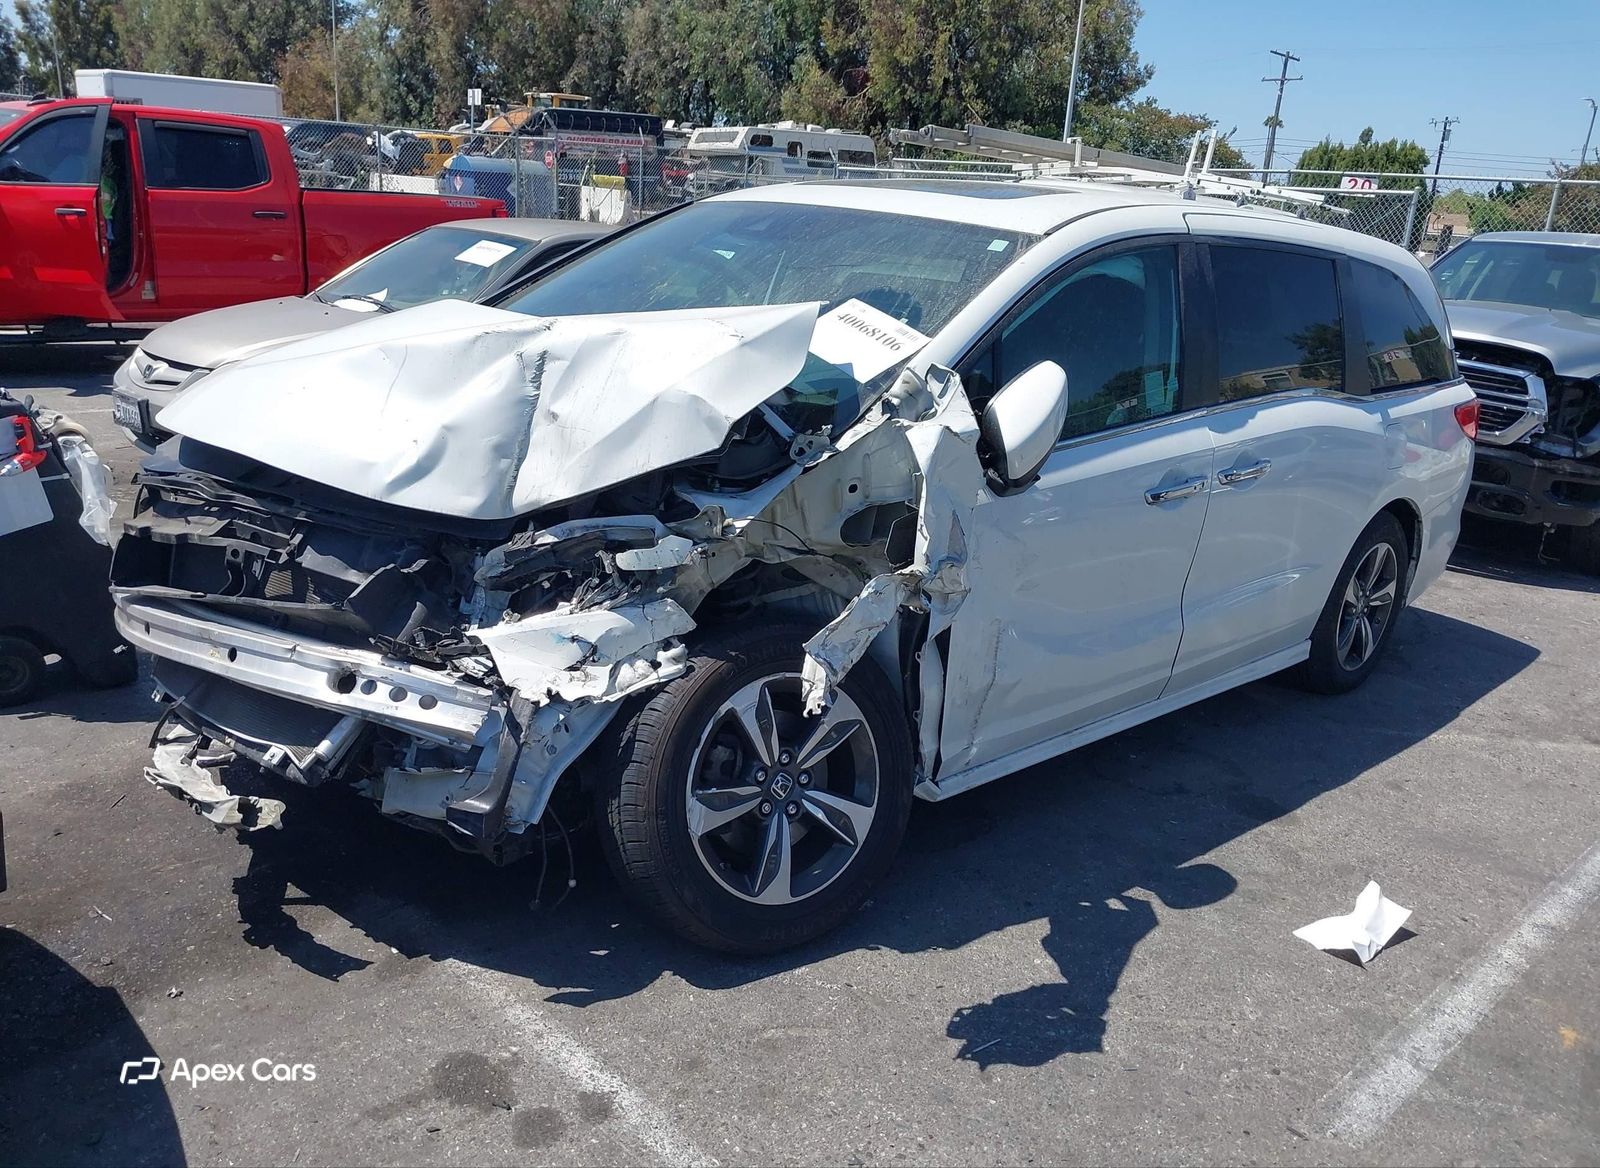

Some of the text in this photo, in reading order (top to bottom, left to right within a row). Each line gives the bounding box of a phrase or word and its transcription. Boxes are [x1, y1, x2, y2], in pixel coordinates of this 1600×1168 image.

[1347, 178, 1373, 191] 20
[837, 313, 904, 351] 40068106
[718, 639, 803, 681] LIONHAR
